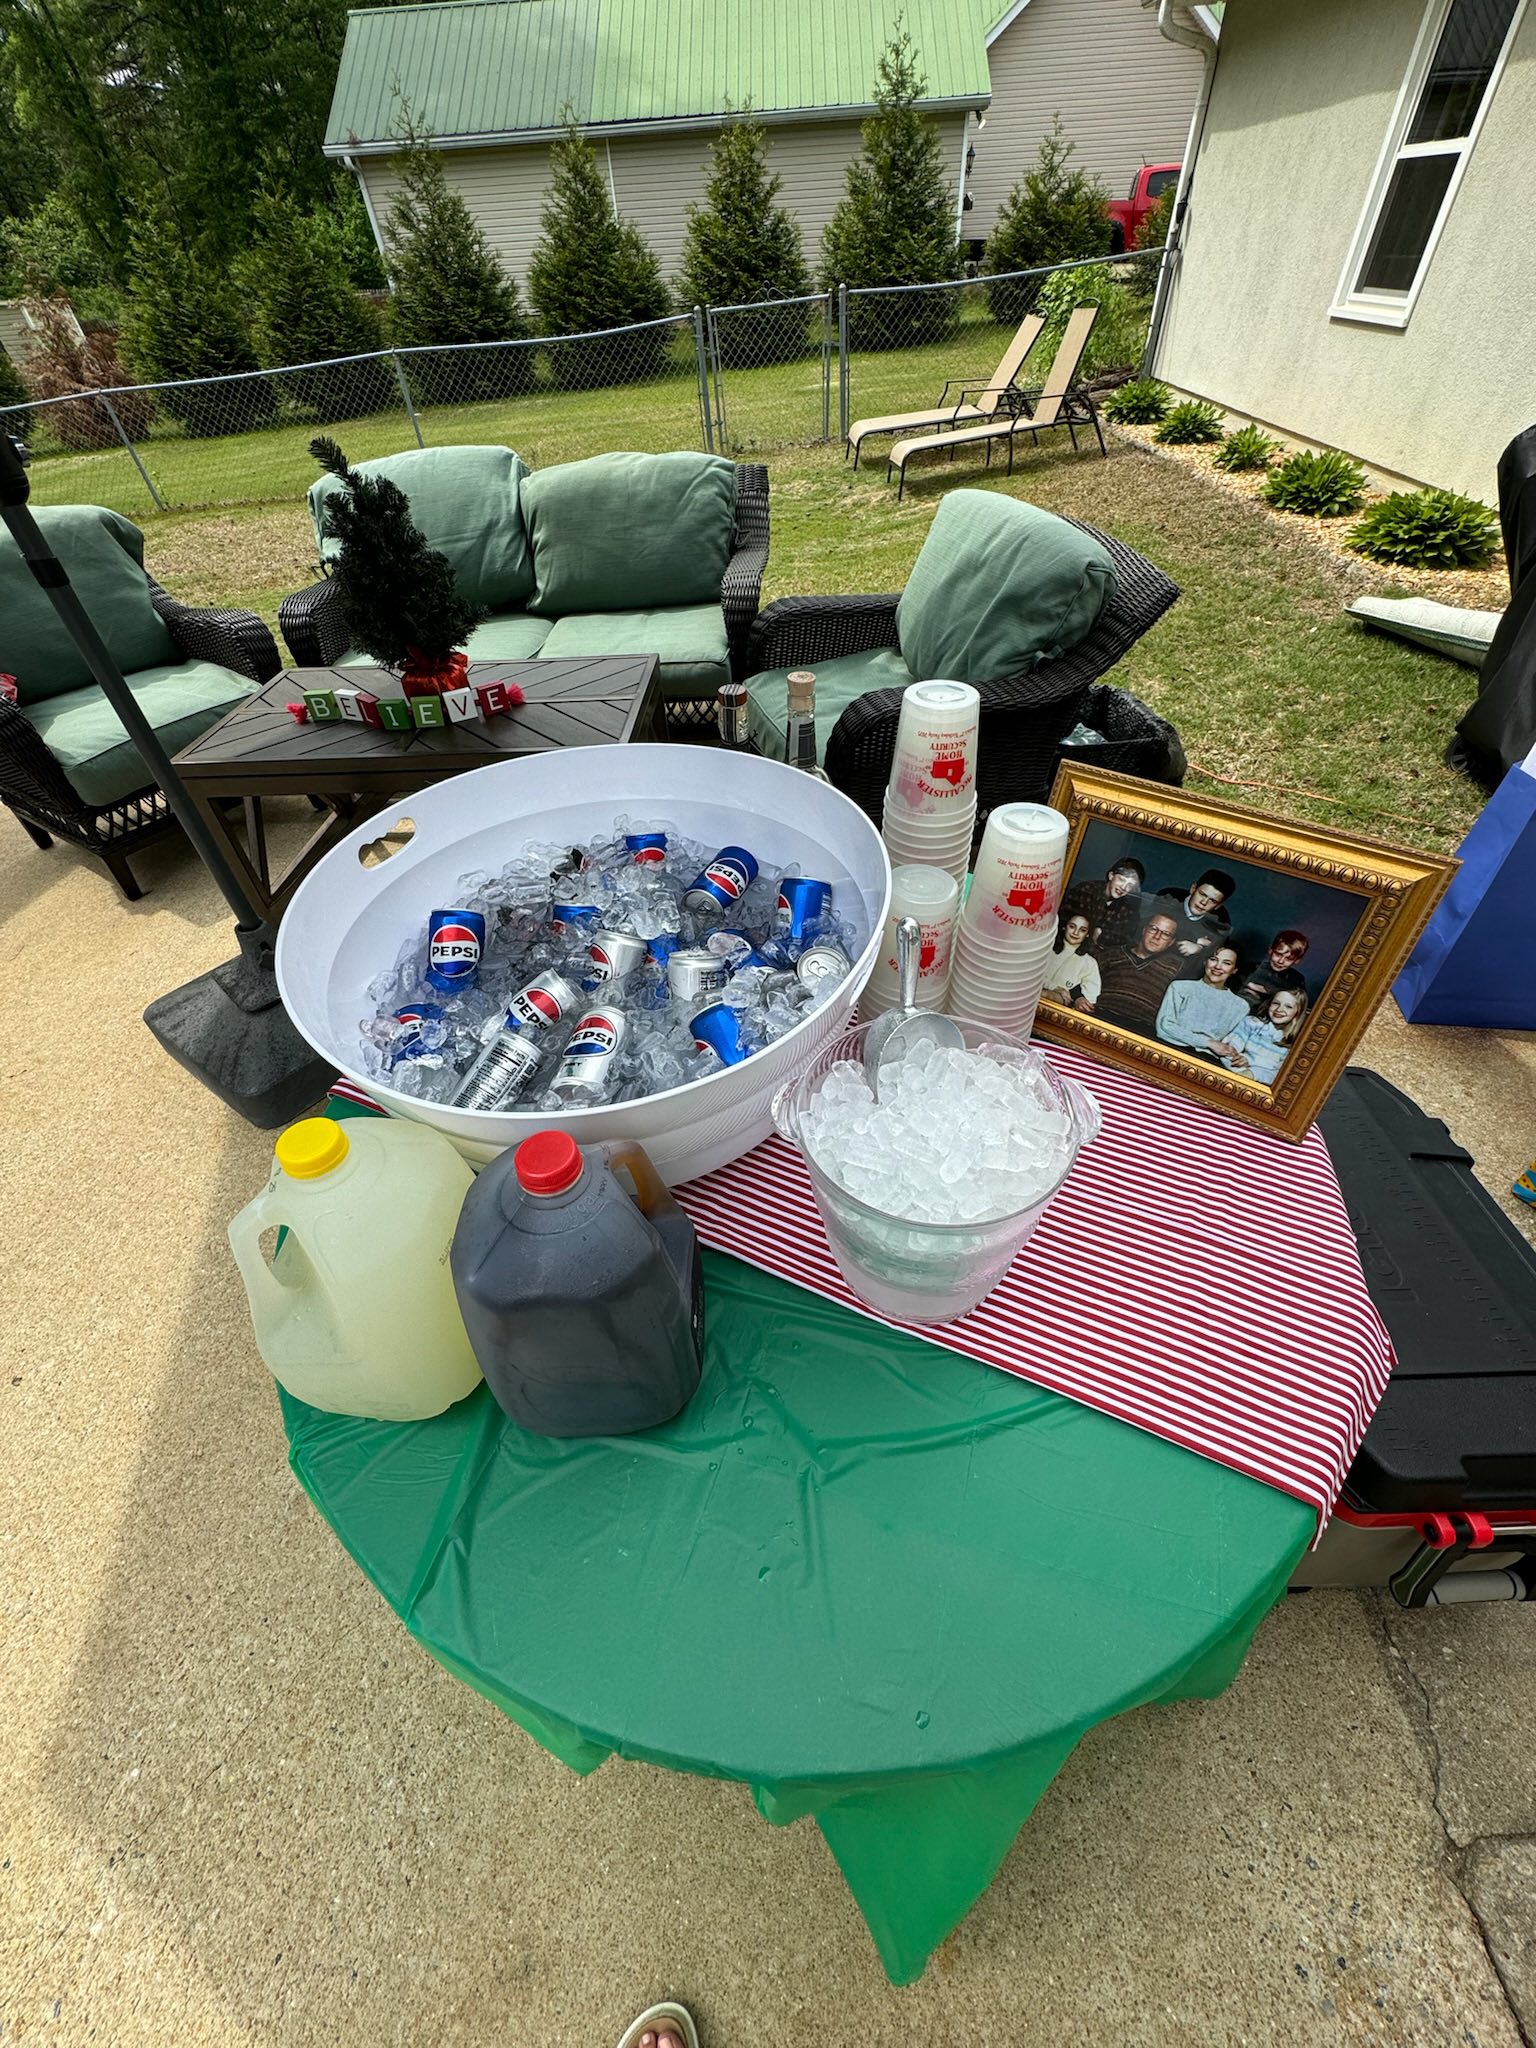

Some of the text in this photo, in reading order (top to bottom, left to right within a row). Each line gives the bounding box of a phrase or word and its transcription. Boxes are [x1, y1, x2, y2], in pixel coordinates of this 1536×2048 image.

[309, 687, 505, 727] BELIEVE
[934, 749, 963, 761] HOME
[709, 864, 745, 894] PEPSI
[1012, 880, 1044, 890] HOME
[431, 945, 478, 959] PEPSI
